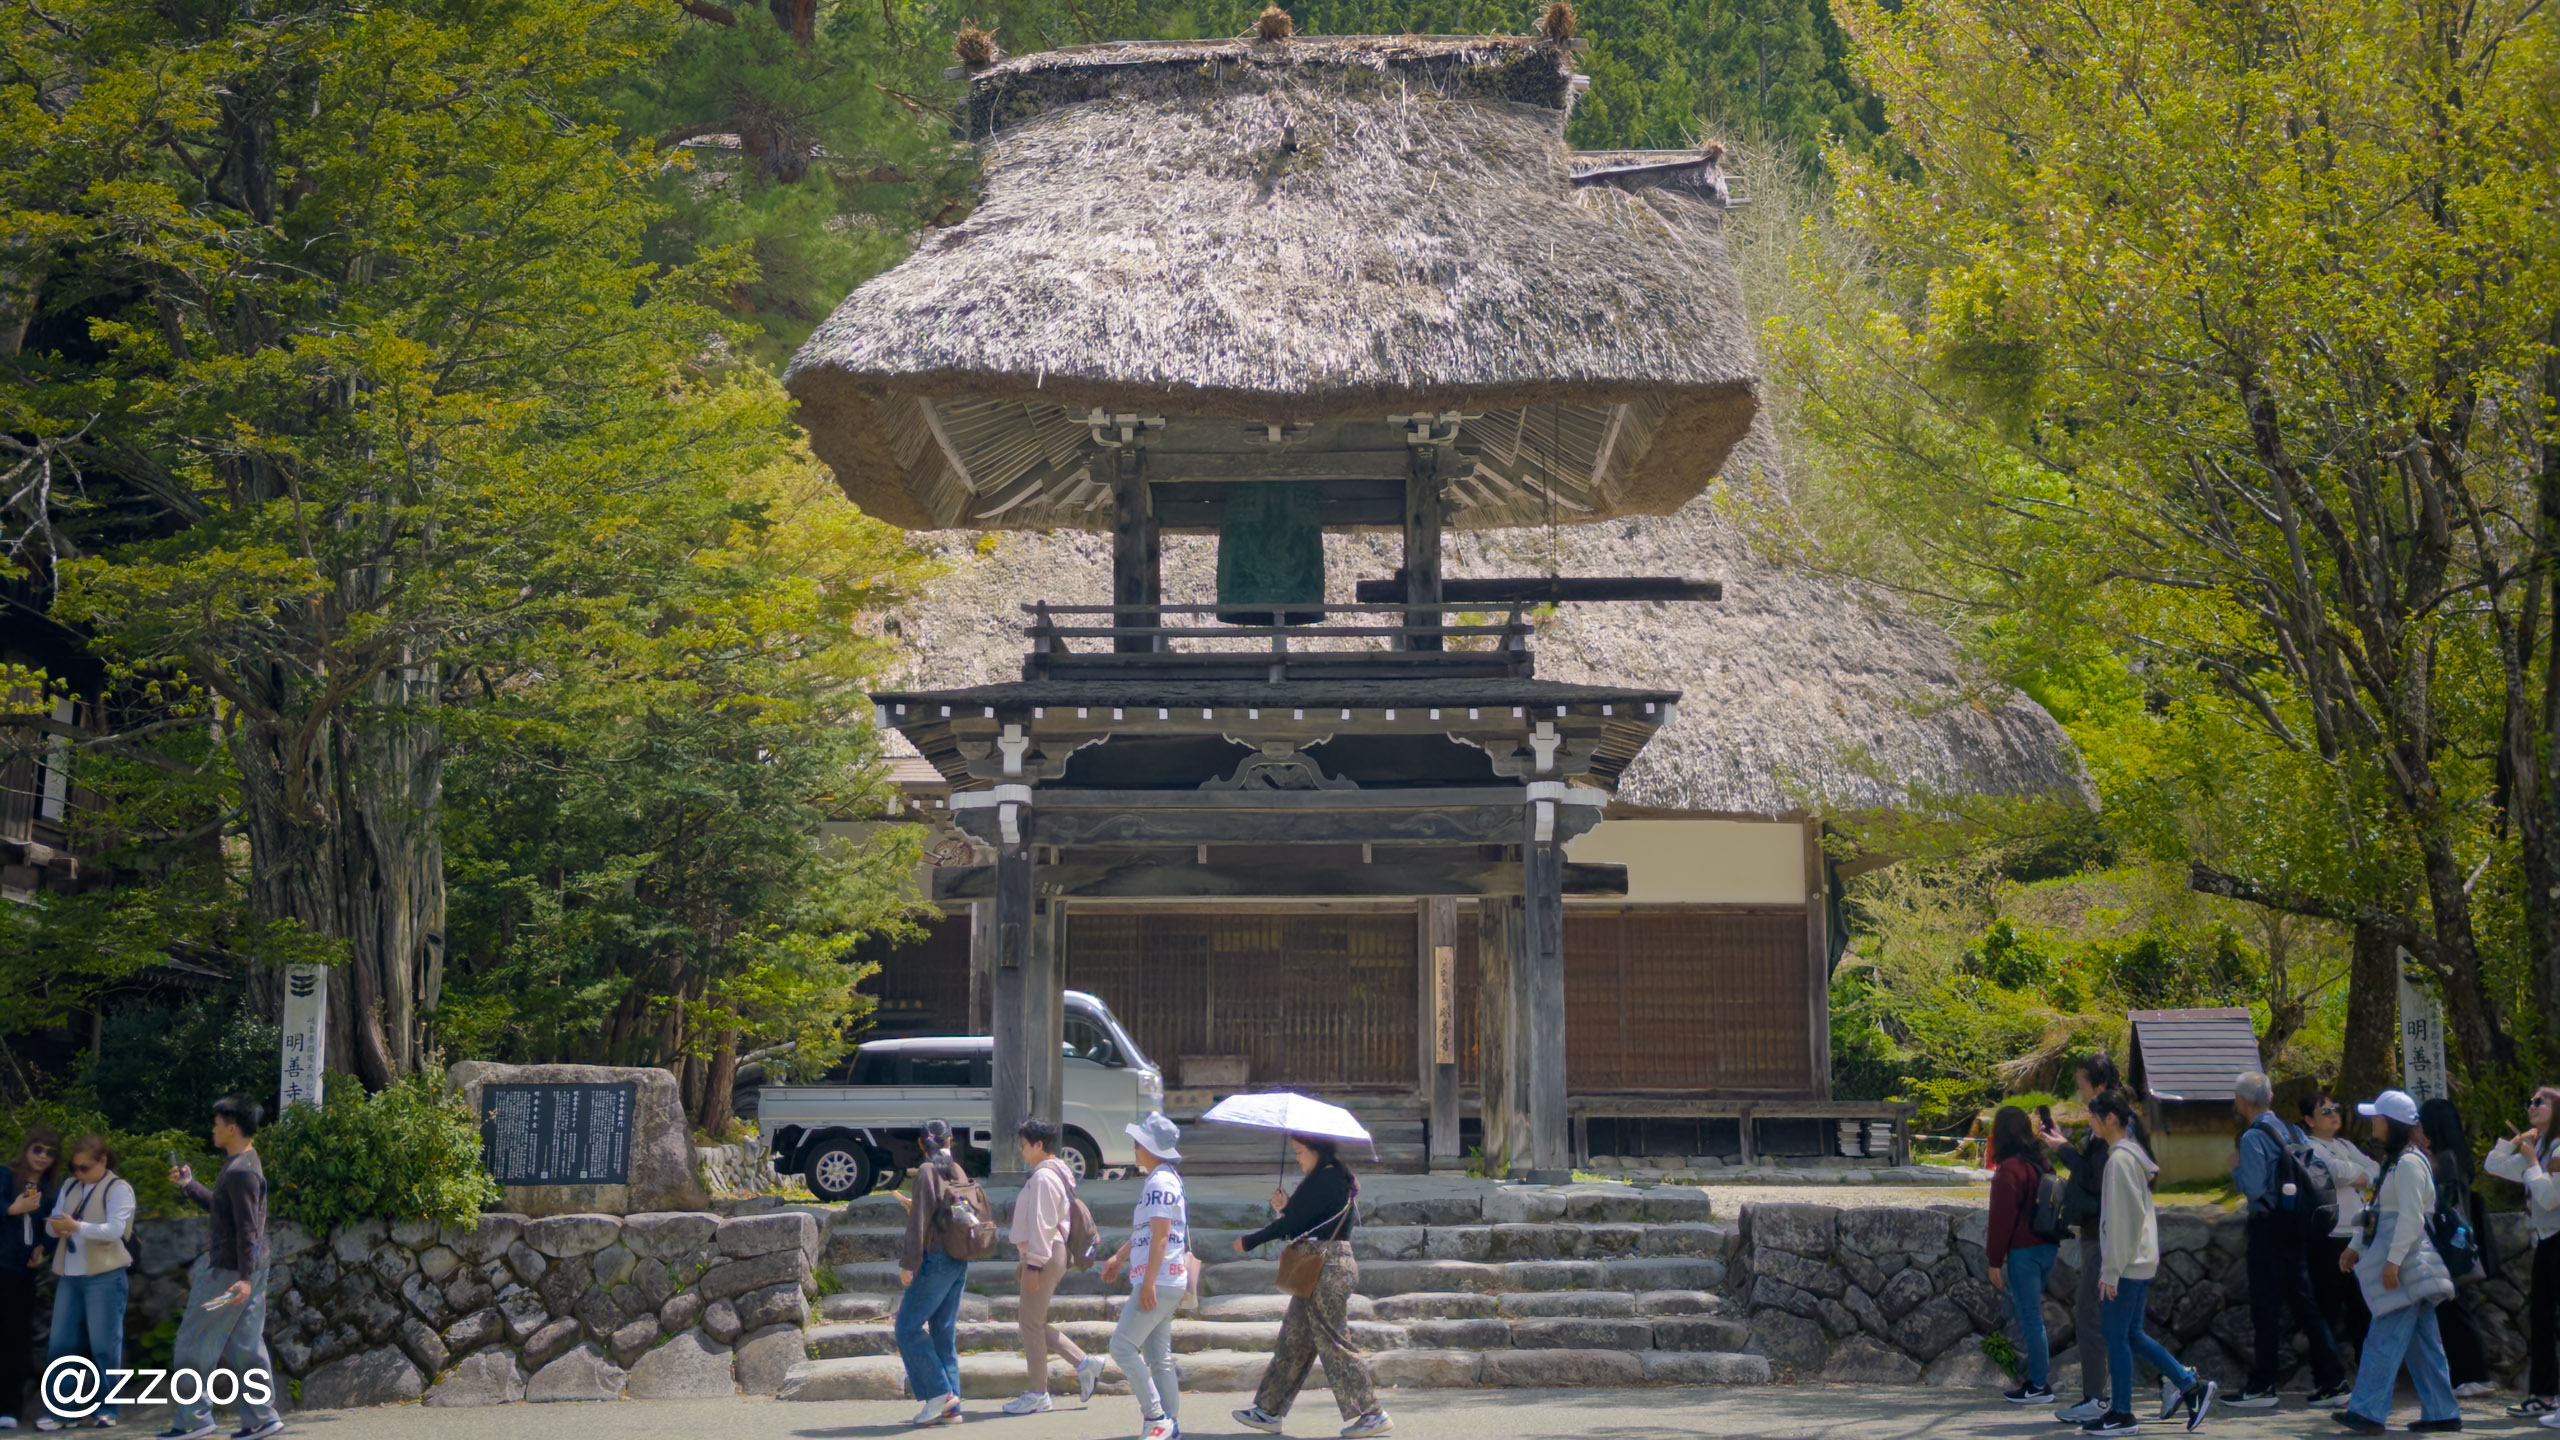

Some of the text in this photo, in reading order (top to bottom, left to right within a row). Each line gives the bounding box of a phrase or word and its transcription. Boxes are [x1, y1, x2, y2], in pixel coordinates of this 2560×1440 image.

[284, 1033, 304, 1103] 明善寺
[2408, 1019, 2432, 1101] 明善寺
